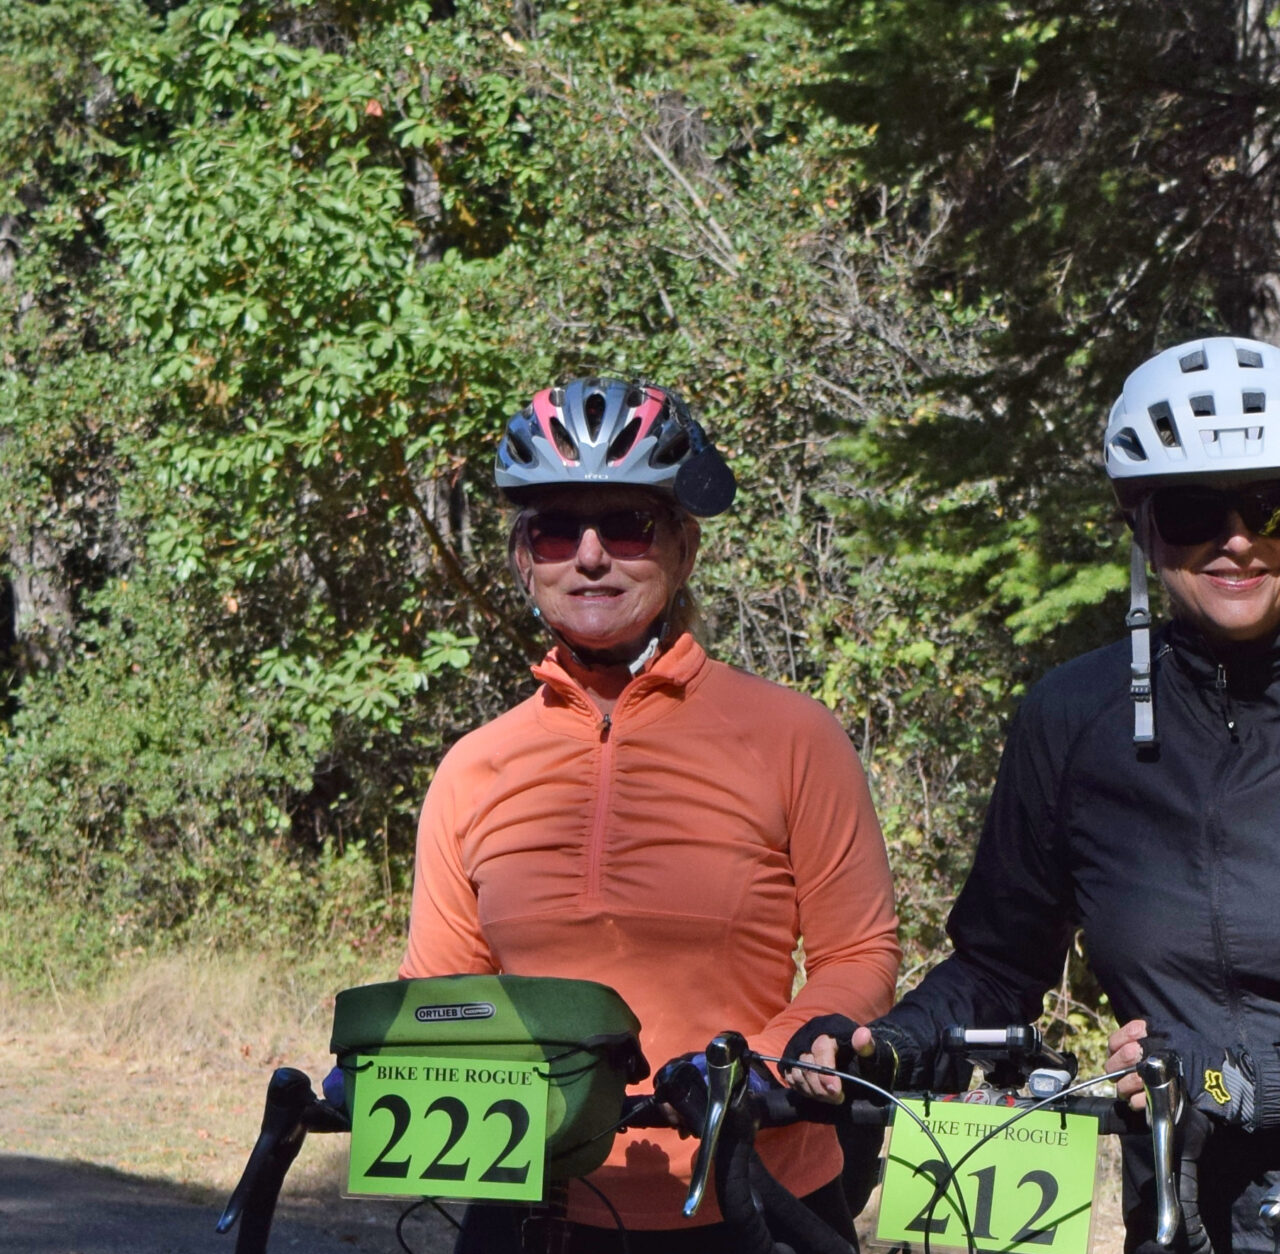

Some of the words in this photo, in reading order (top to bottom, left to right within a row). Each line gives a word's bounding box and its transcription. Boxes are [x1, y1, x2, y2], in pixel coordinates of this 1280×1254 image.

[419, 1007, 458, 1019] ORTLIEB
[376, 1065, 418, 1081] BIKE
[422, 1067, 459, 1083] THE
[465, 1068, 533, 1086] ROGUE
[363, 1093, 532, 1185] 222
[920, 1119, 960, 1136] BIKE
[964, 1122, 1000, 1141] THE
[1004, 1127, 1069, 1147] ROGUE
[904, 1159, 1060, 1246] 212
